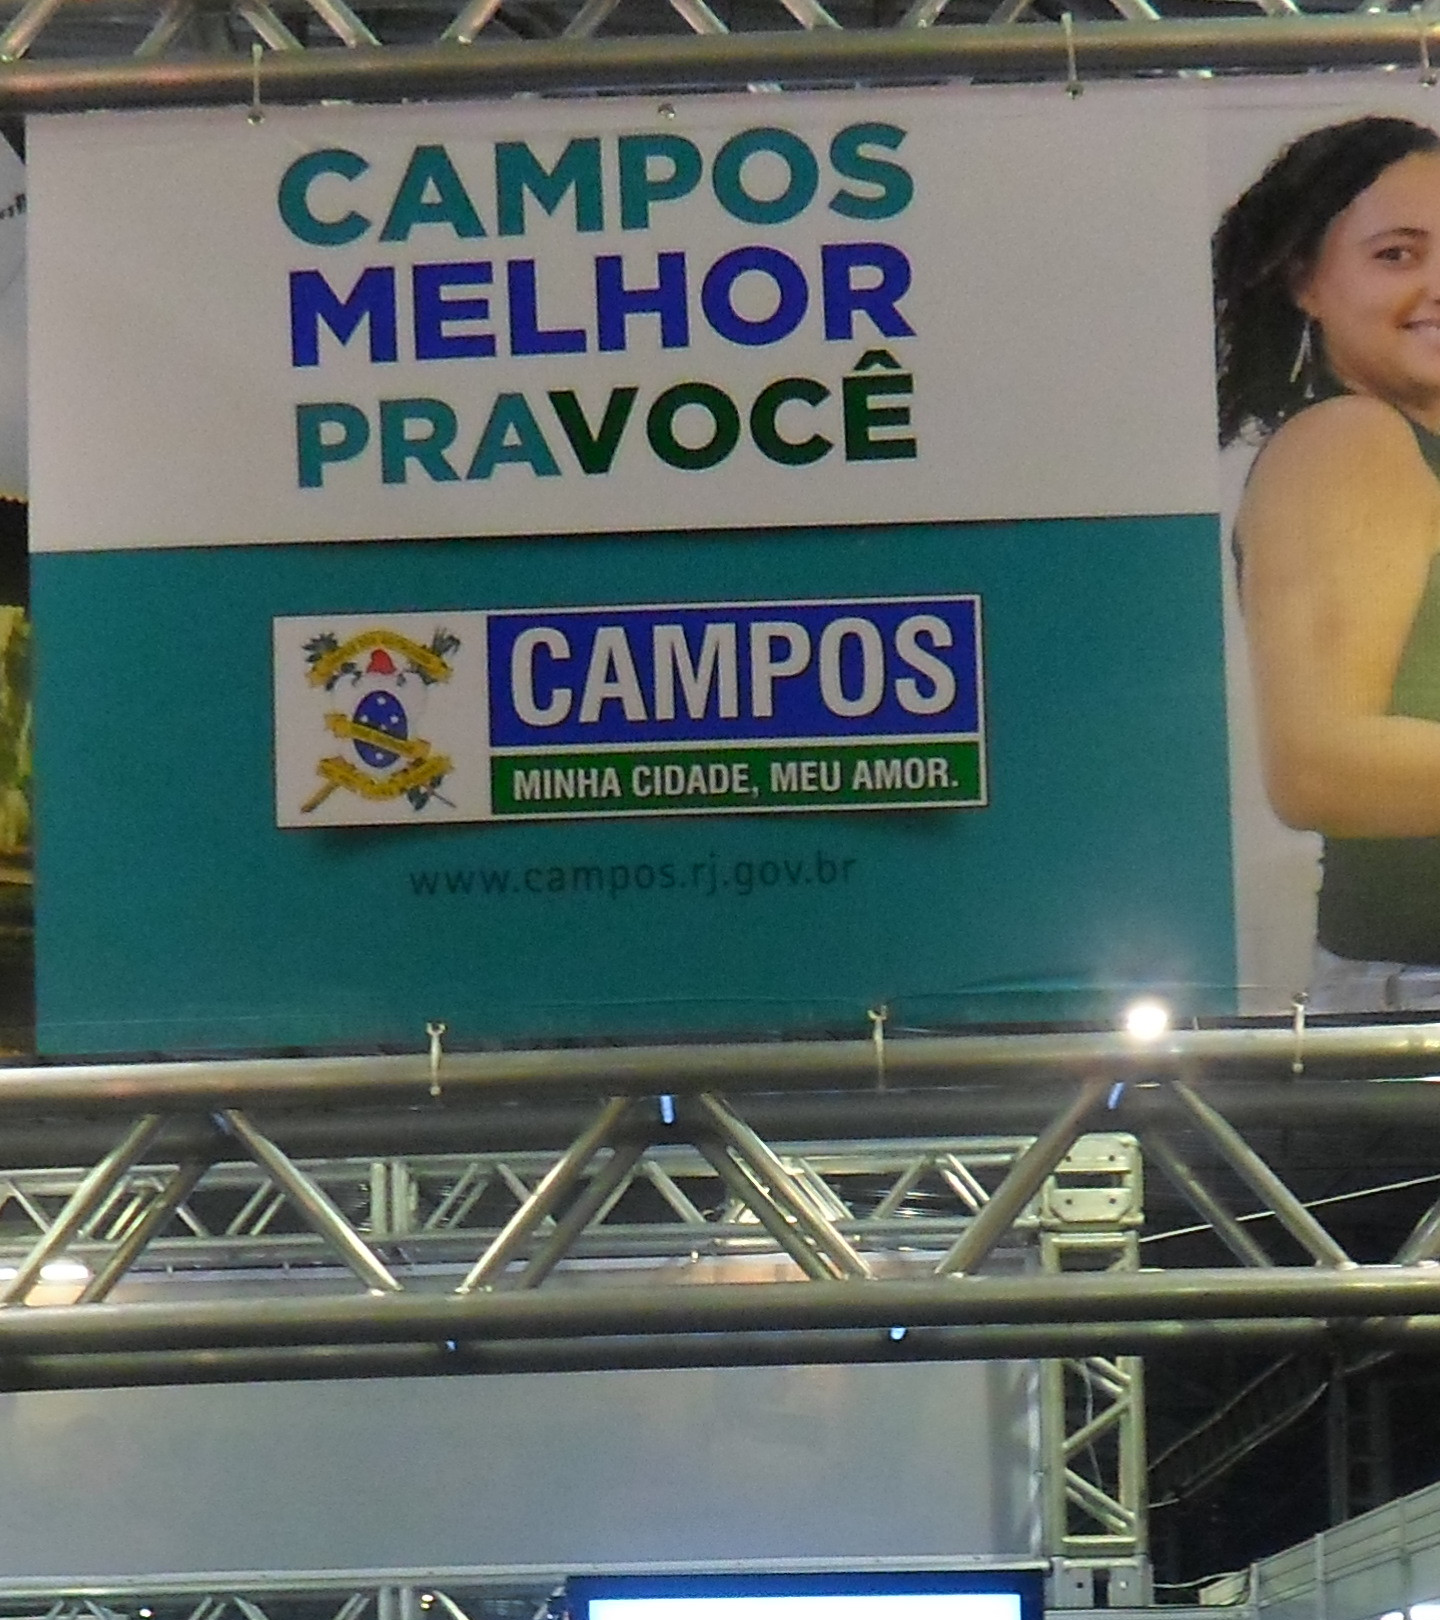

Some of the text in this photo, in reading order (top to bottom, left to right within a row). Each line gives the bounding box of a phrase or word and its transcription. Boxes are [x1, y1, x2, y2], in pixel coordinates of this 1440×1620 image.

[277, 121, 915, 246] CAMPOS
[288, 242, 916, 367] MELHOR
[509, 614, 957, 727] CAMPOS
[512, 757, 960, 800] MINHA CIDADE, MEU AMOR.
[408, 850, 858, 898] www.campos.rj.gov.br
